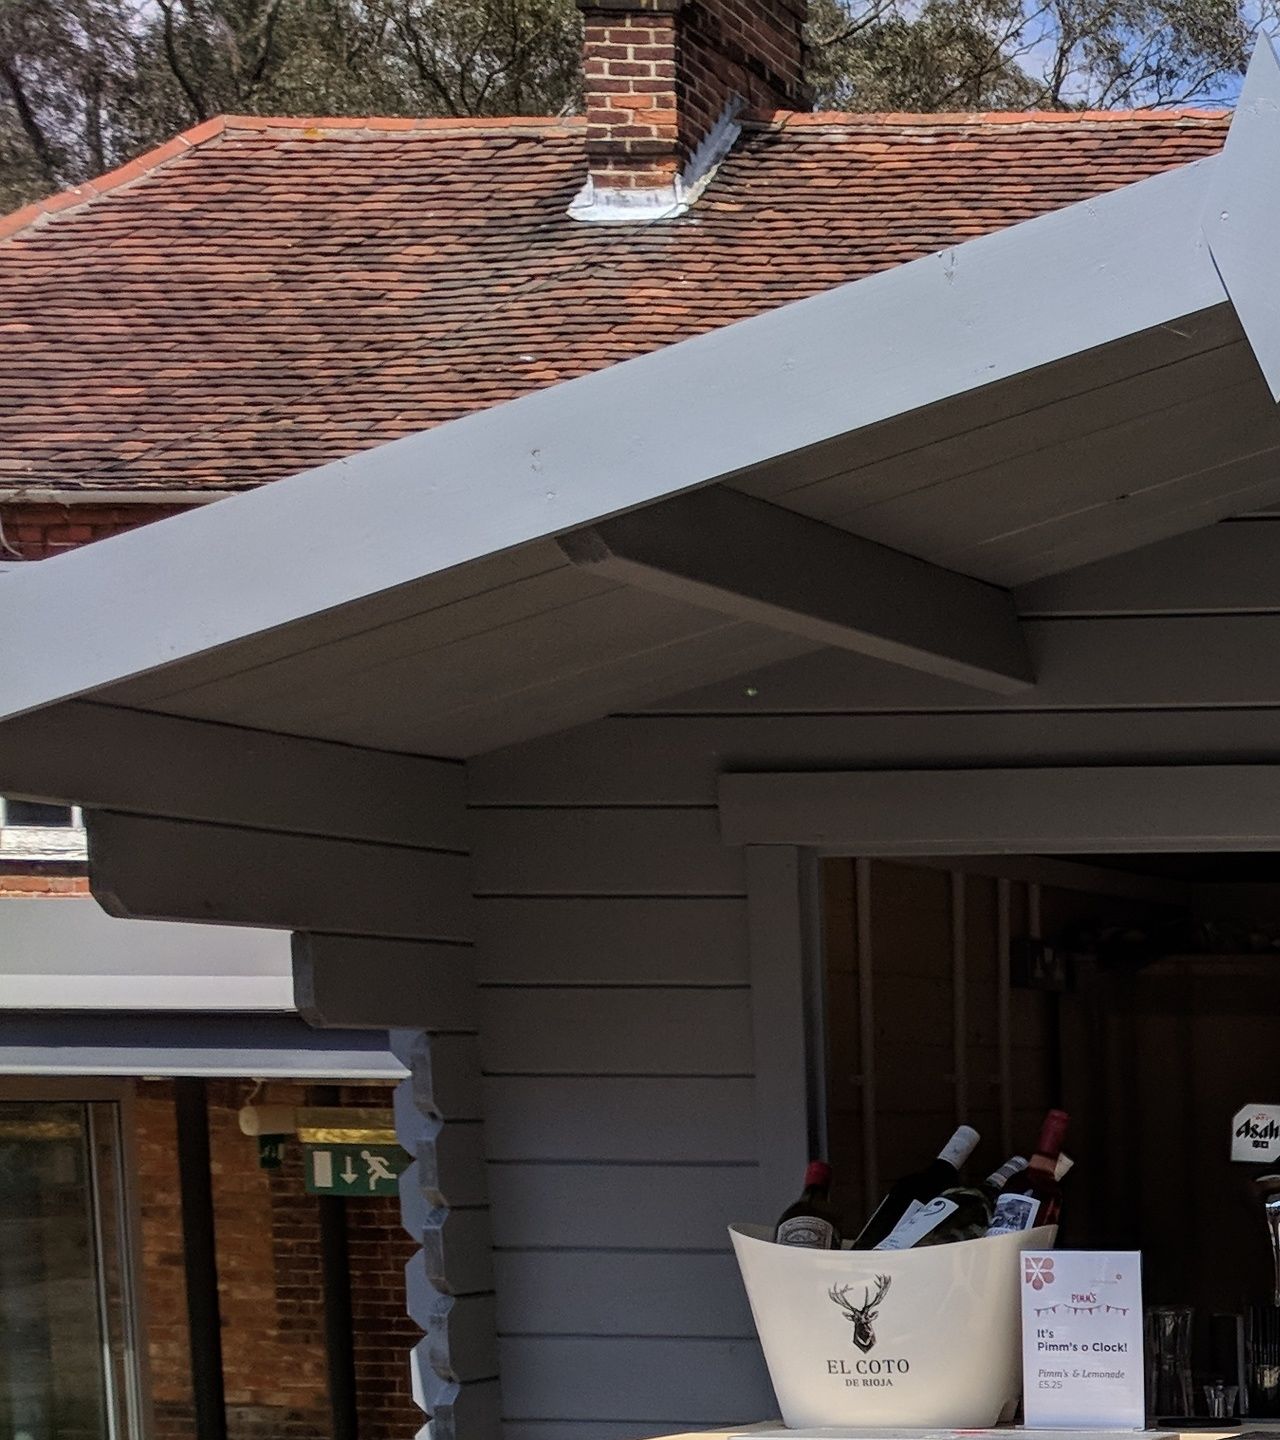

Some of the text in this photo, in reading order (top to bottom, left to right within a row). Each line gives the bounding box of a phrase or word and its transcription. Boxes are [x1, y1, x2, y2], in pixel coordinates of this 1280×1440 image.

[1037, 1329, 1054, 1338] It's
[1037, 1342, 1078, 1352] Pimm's
[1092, 1342, 1128, 1353] Clock!
[826, 1359, 909, 1375] EL COTO
[1038, 1369, 1125, 1379] Pimm's & Lemonade
[845, 1379, 893, 1387] DE RIOJA
